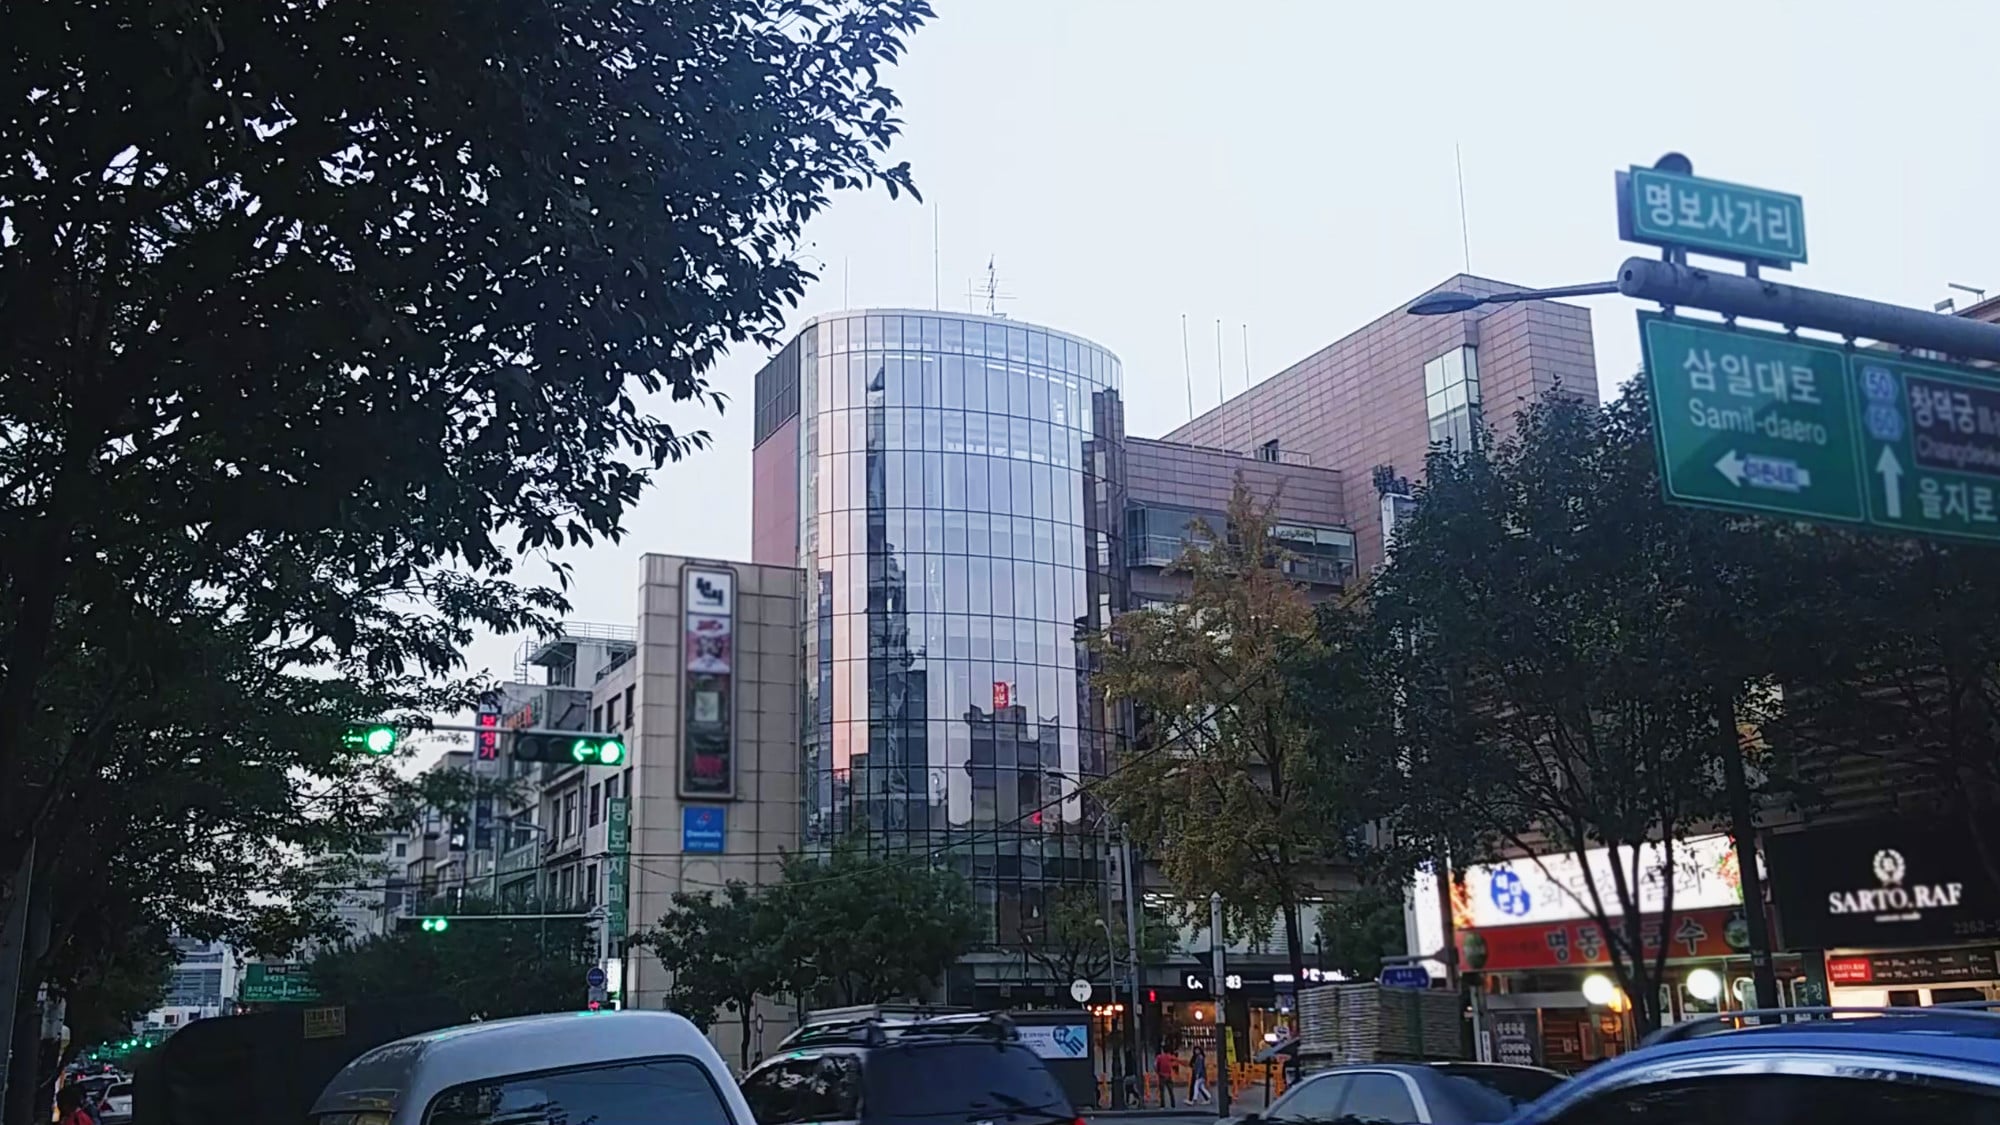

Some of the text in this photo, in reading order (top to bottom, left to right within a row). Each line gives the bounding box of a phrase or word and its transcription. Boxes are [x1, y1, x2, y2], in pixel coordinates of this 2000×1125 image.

[1645, 183, 1793, 249] 명보사거리
[1682, 348, 1822, 405] 삼일대로
[1689, 398, 1827, 446] Samil-daero
[1911, 385, 1975, 434] 창덕궁
[1917, 477, 1998, 523] 을지로
[1828, 882, 1963, 914] SARTO.RAF
